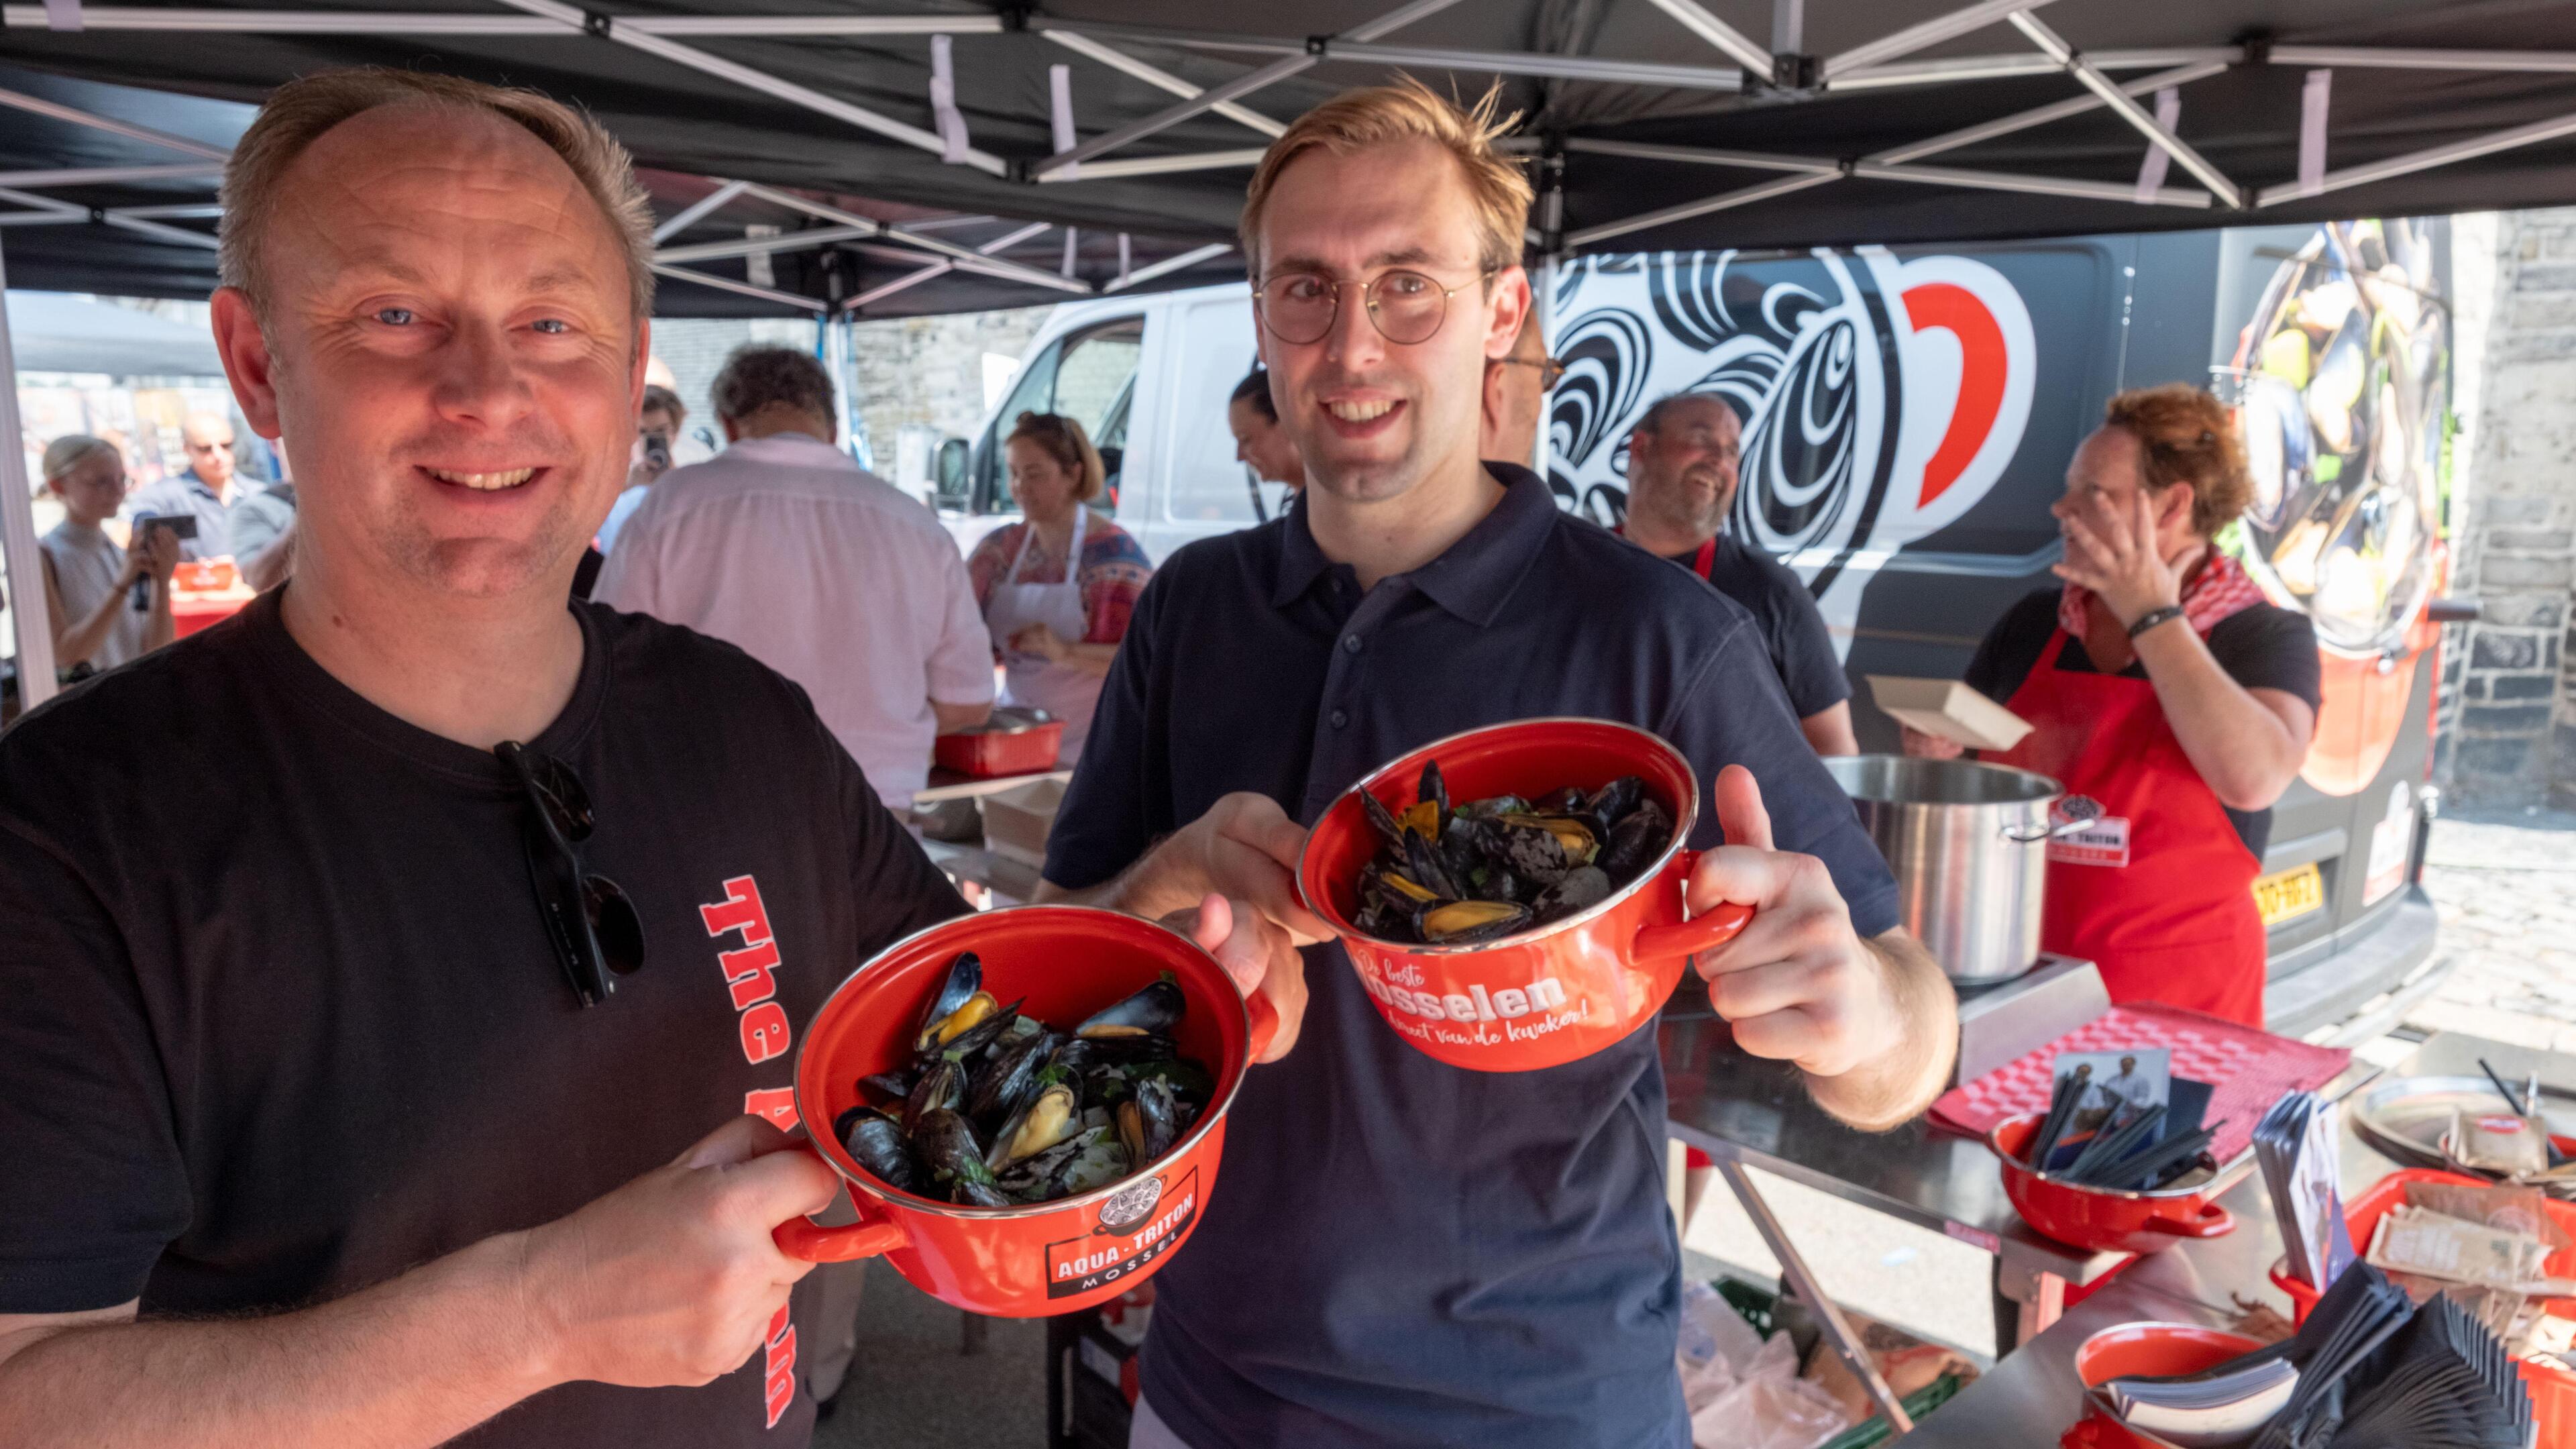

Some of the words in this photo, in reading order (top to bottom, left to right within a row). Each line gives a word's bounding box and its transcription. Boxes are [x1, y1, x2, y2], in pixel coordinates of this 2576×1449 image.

[699, 874, 792, 1065] The
[1384, 957, 1426, 987] beste
[1435, 1029, 1473, 1046] van
[1474, 1023, 1503, 1046] de
[1505, 998, 1591, 1042] kweker!
[1058, 1246, 1120, 1279] AQUA
[1133, 1193, 1193, 1250] TRITON
[1081, 1232, 1177, 1289] MOSSEL
